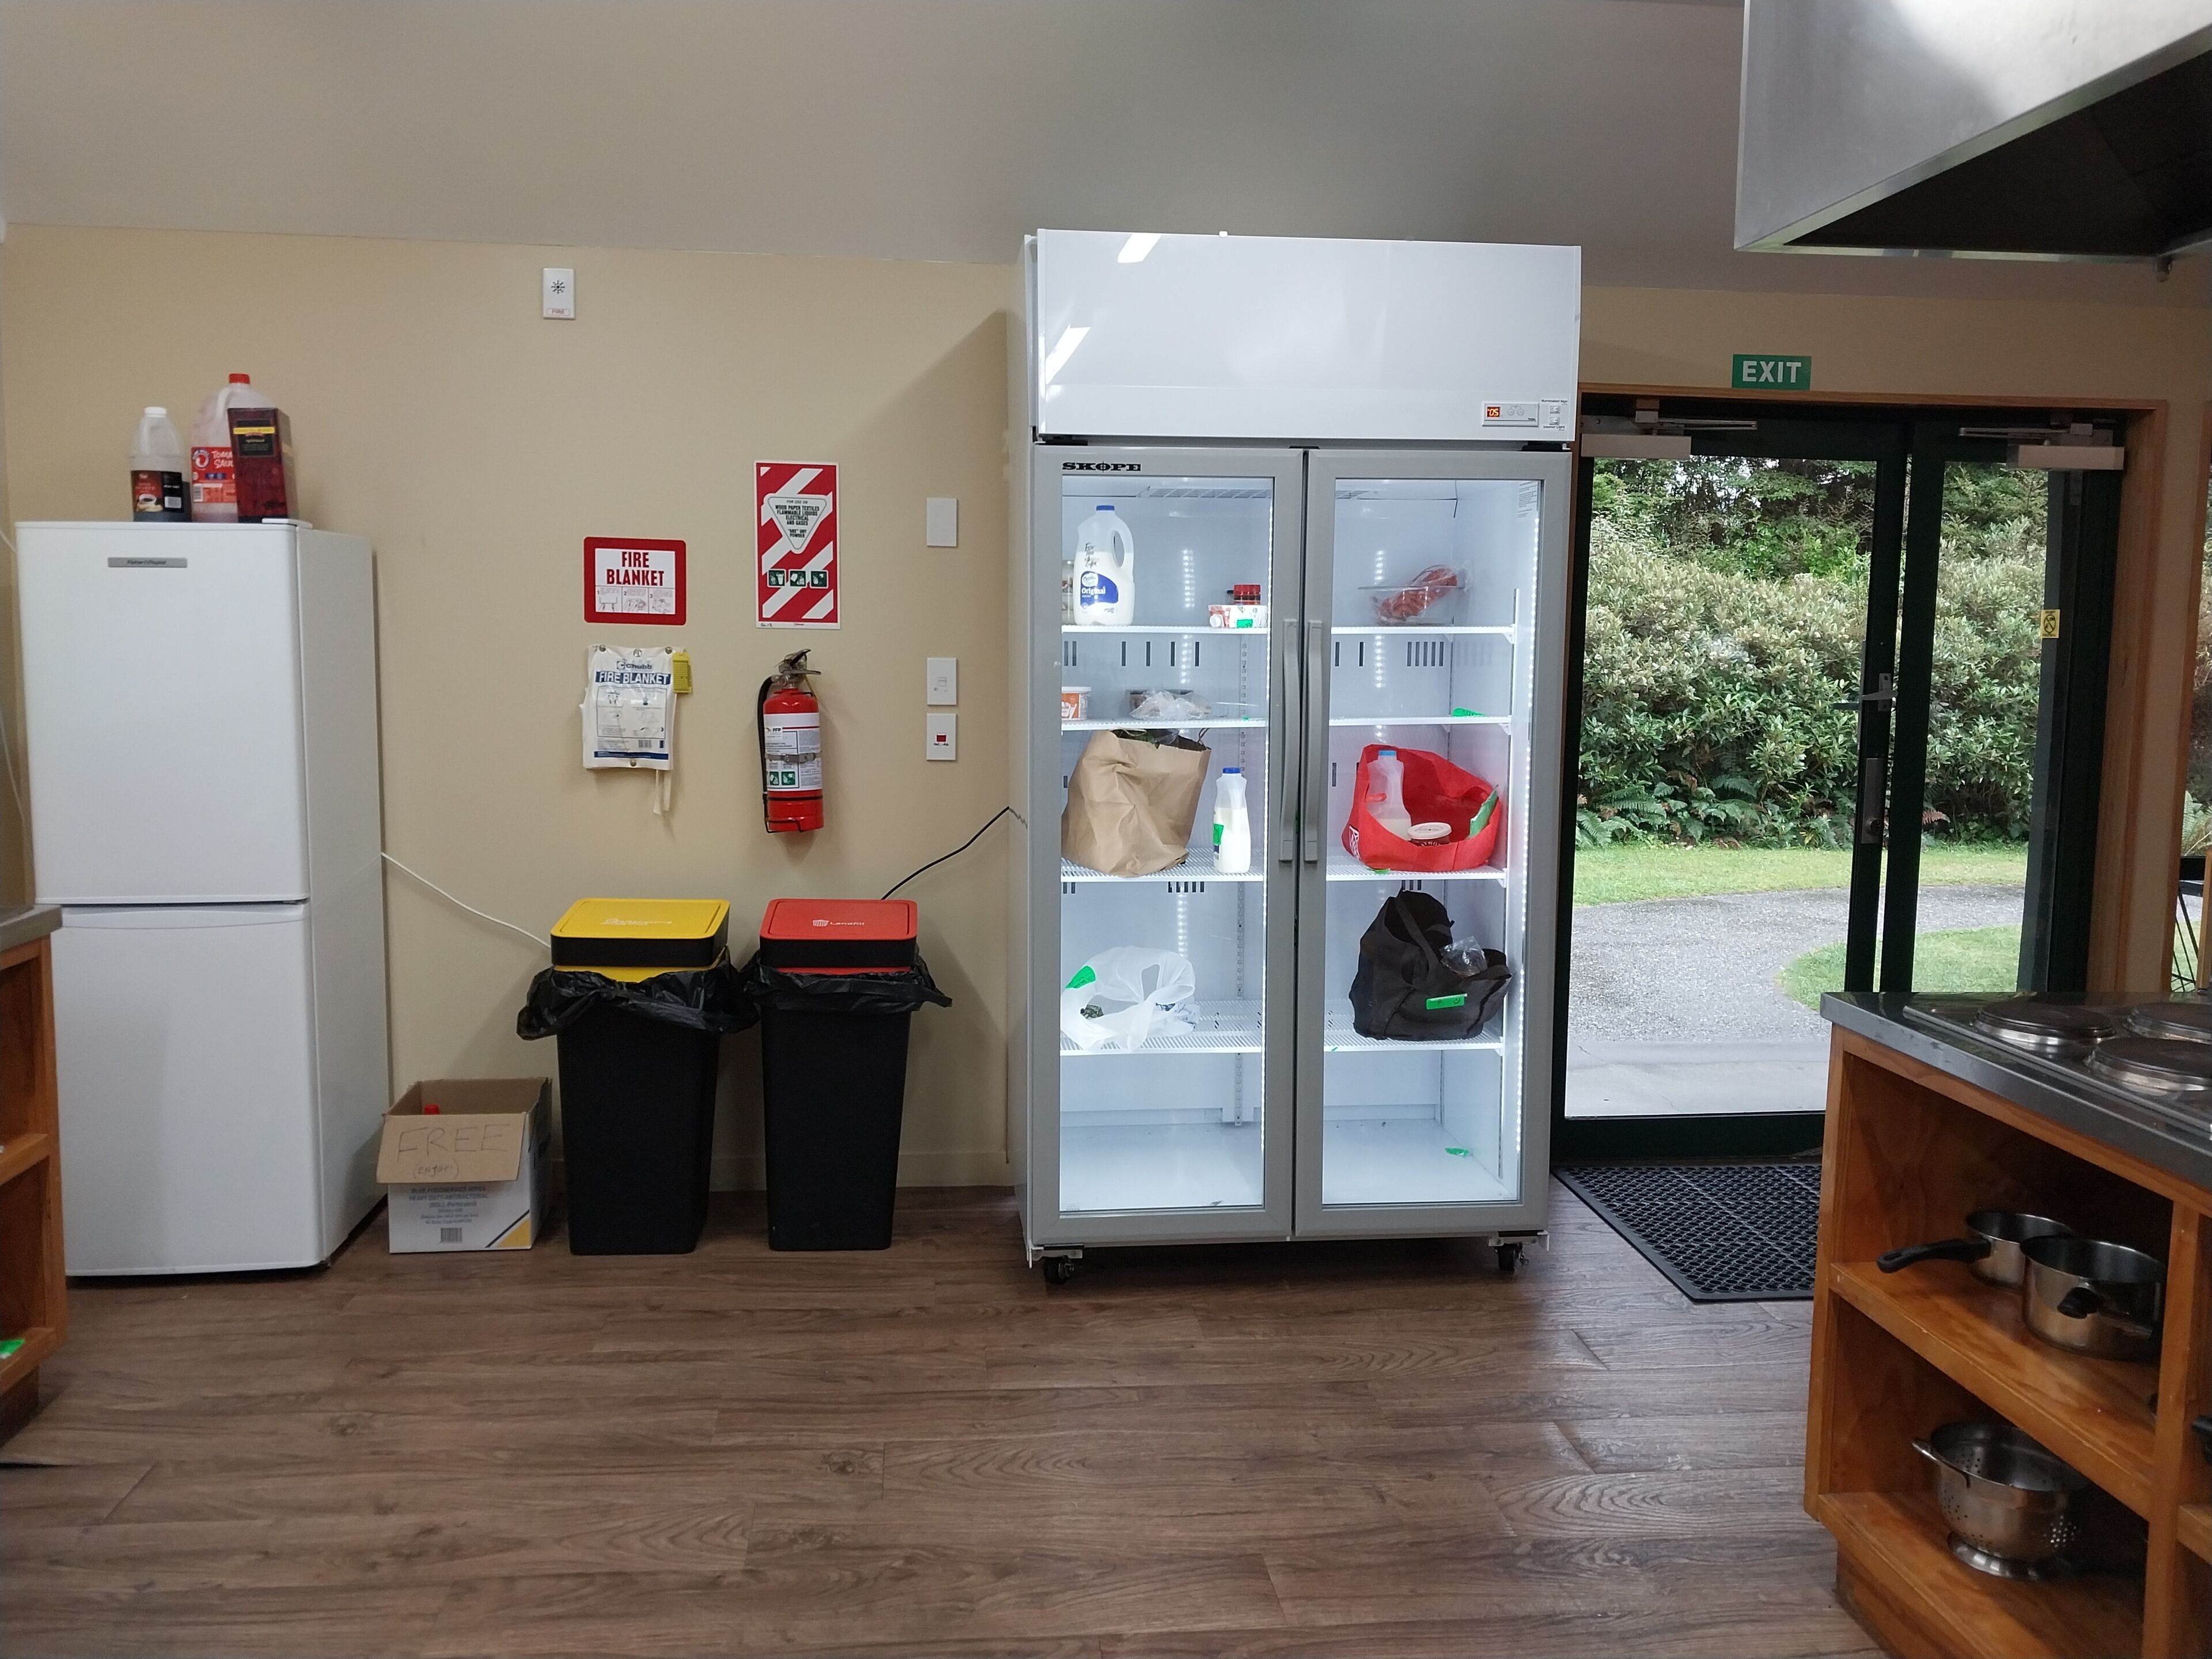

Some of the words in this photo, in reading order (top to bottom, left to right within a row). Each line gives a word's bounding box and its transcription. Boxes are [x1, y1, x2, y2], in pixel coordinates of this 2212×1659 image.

[1743, 361, 1802, 383] EXIT
[211, 450, 233, 459] TOMA
[214, 459, 234, 469] SAUC
[1062, 461, 1141, 472] SKOPE
[622, 551, 649, 568] FIRE
[607, 569, 664, 586] BLANKET
[1081, 586, 1106, 595] Original
[600, 671, 621, 683] FIRE
[623, 672, 669, 685] BLANKET
[397, 1124, 511, 1164] FREE
